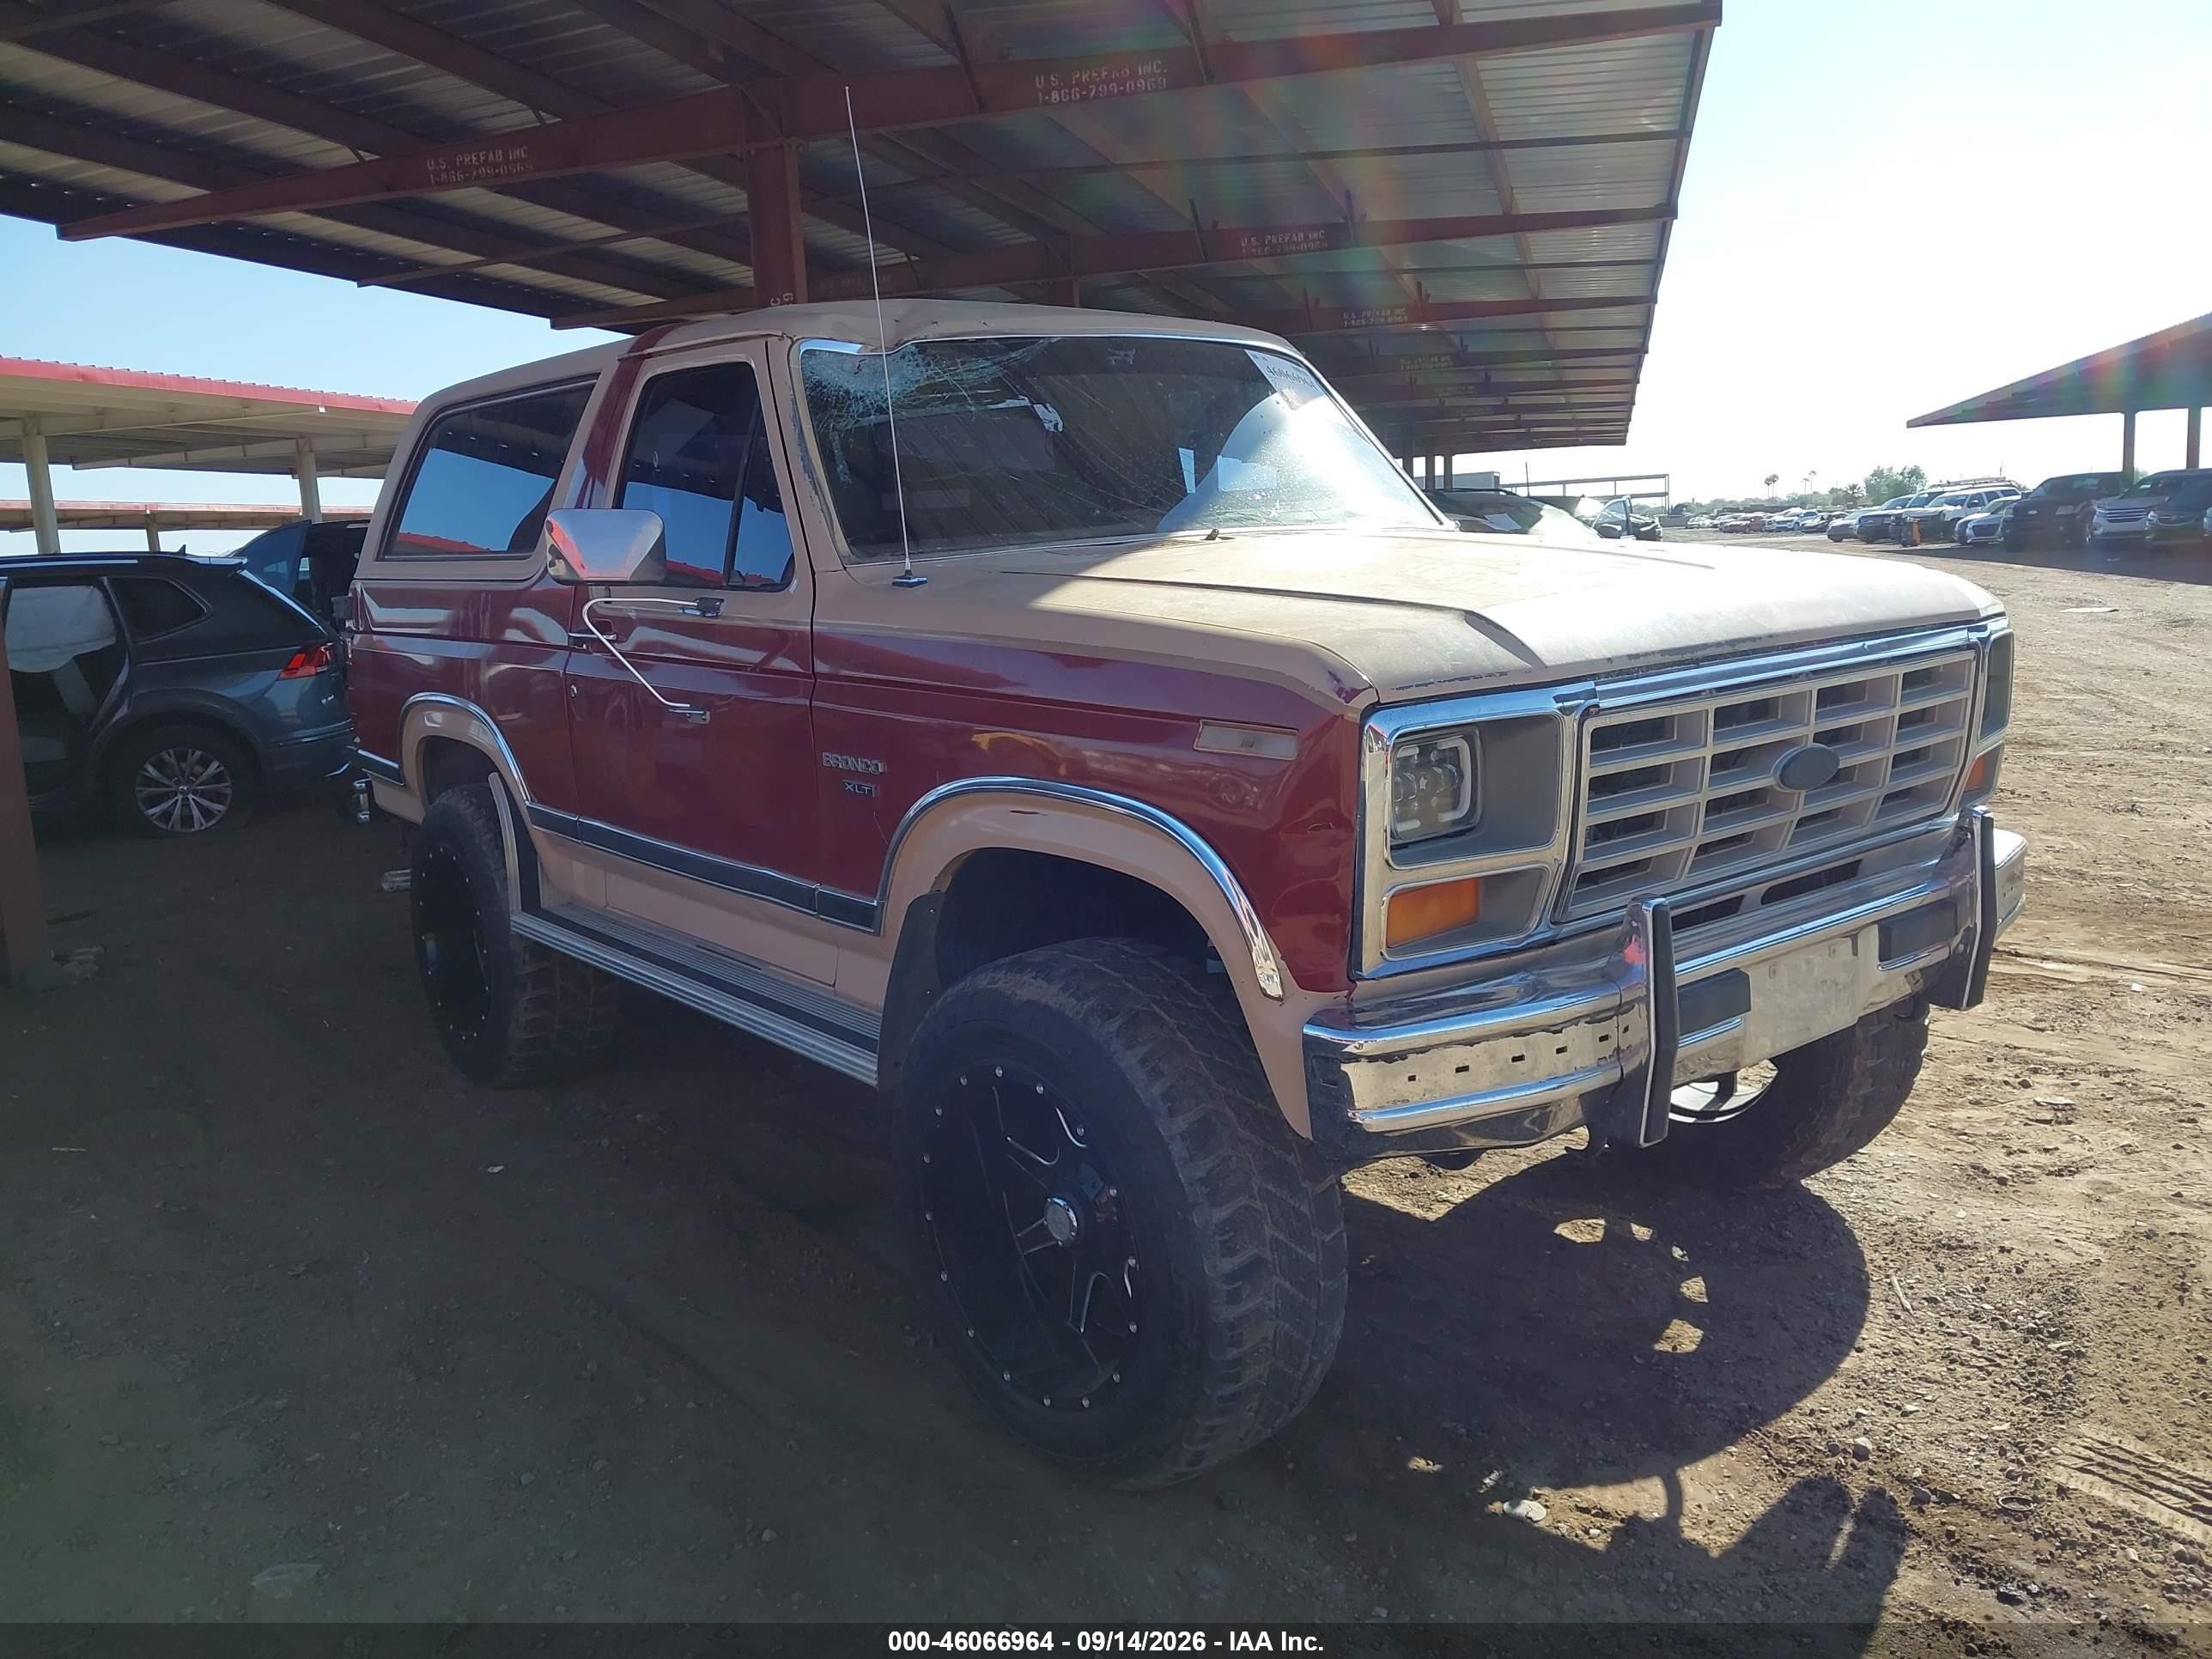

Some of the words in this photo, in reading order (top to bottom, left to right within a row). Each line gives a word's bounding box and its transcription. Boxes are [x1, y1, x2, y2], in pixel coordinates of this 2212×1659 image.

[1071, 64, 1130, 84] PREFAB
[1138, 59, 1168, 76] INC.
[456, 149, 502, 167] PREFAB
[1265, 232, 1304, 245] PREFAB
[823, 751, 886, 775] BRONCO
[844, 781, 874, 795] XLT
